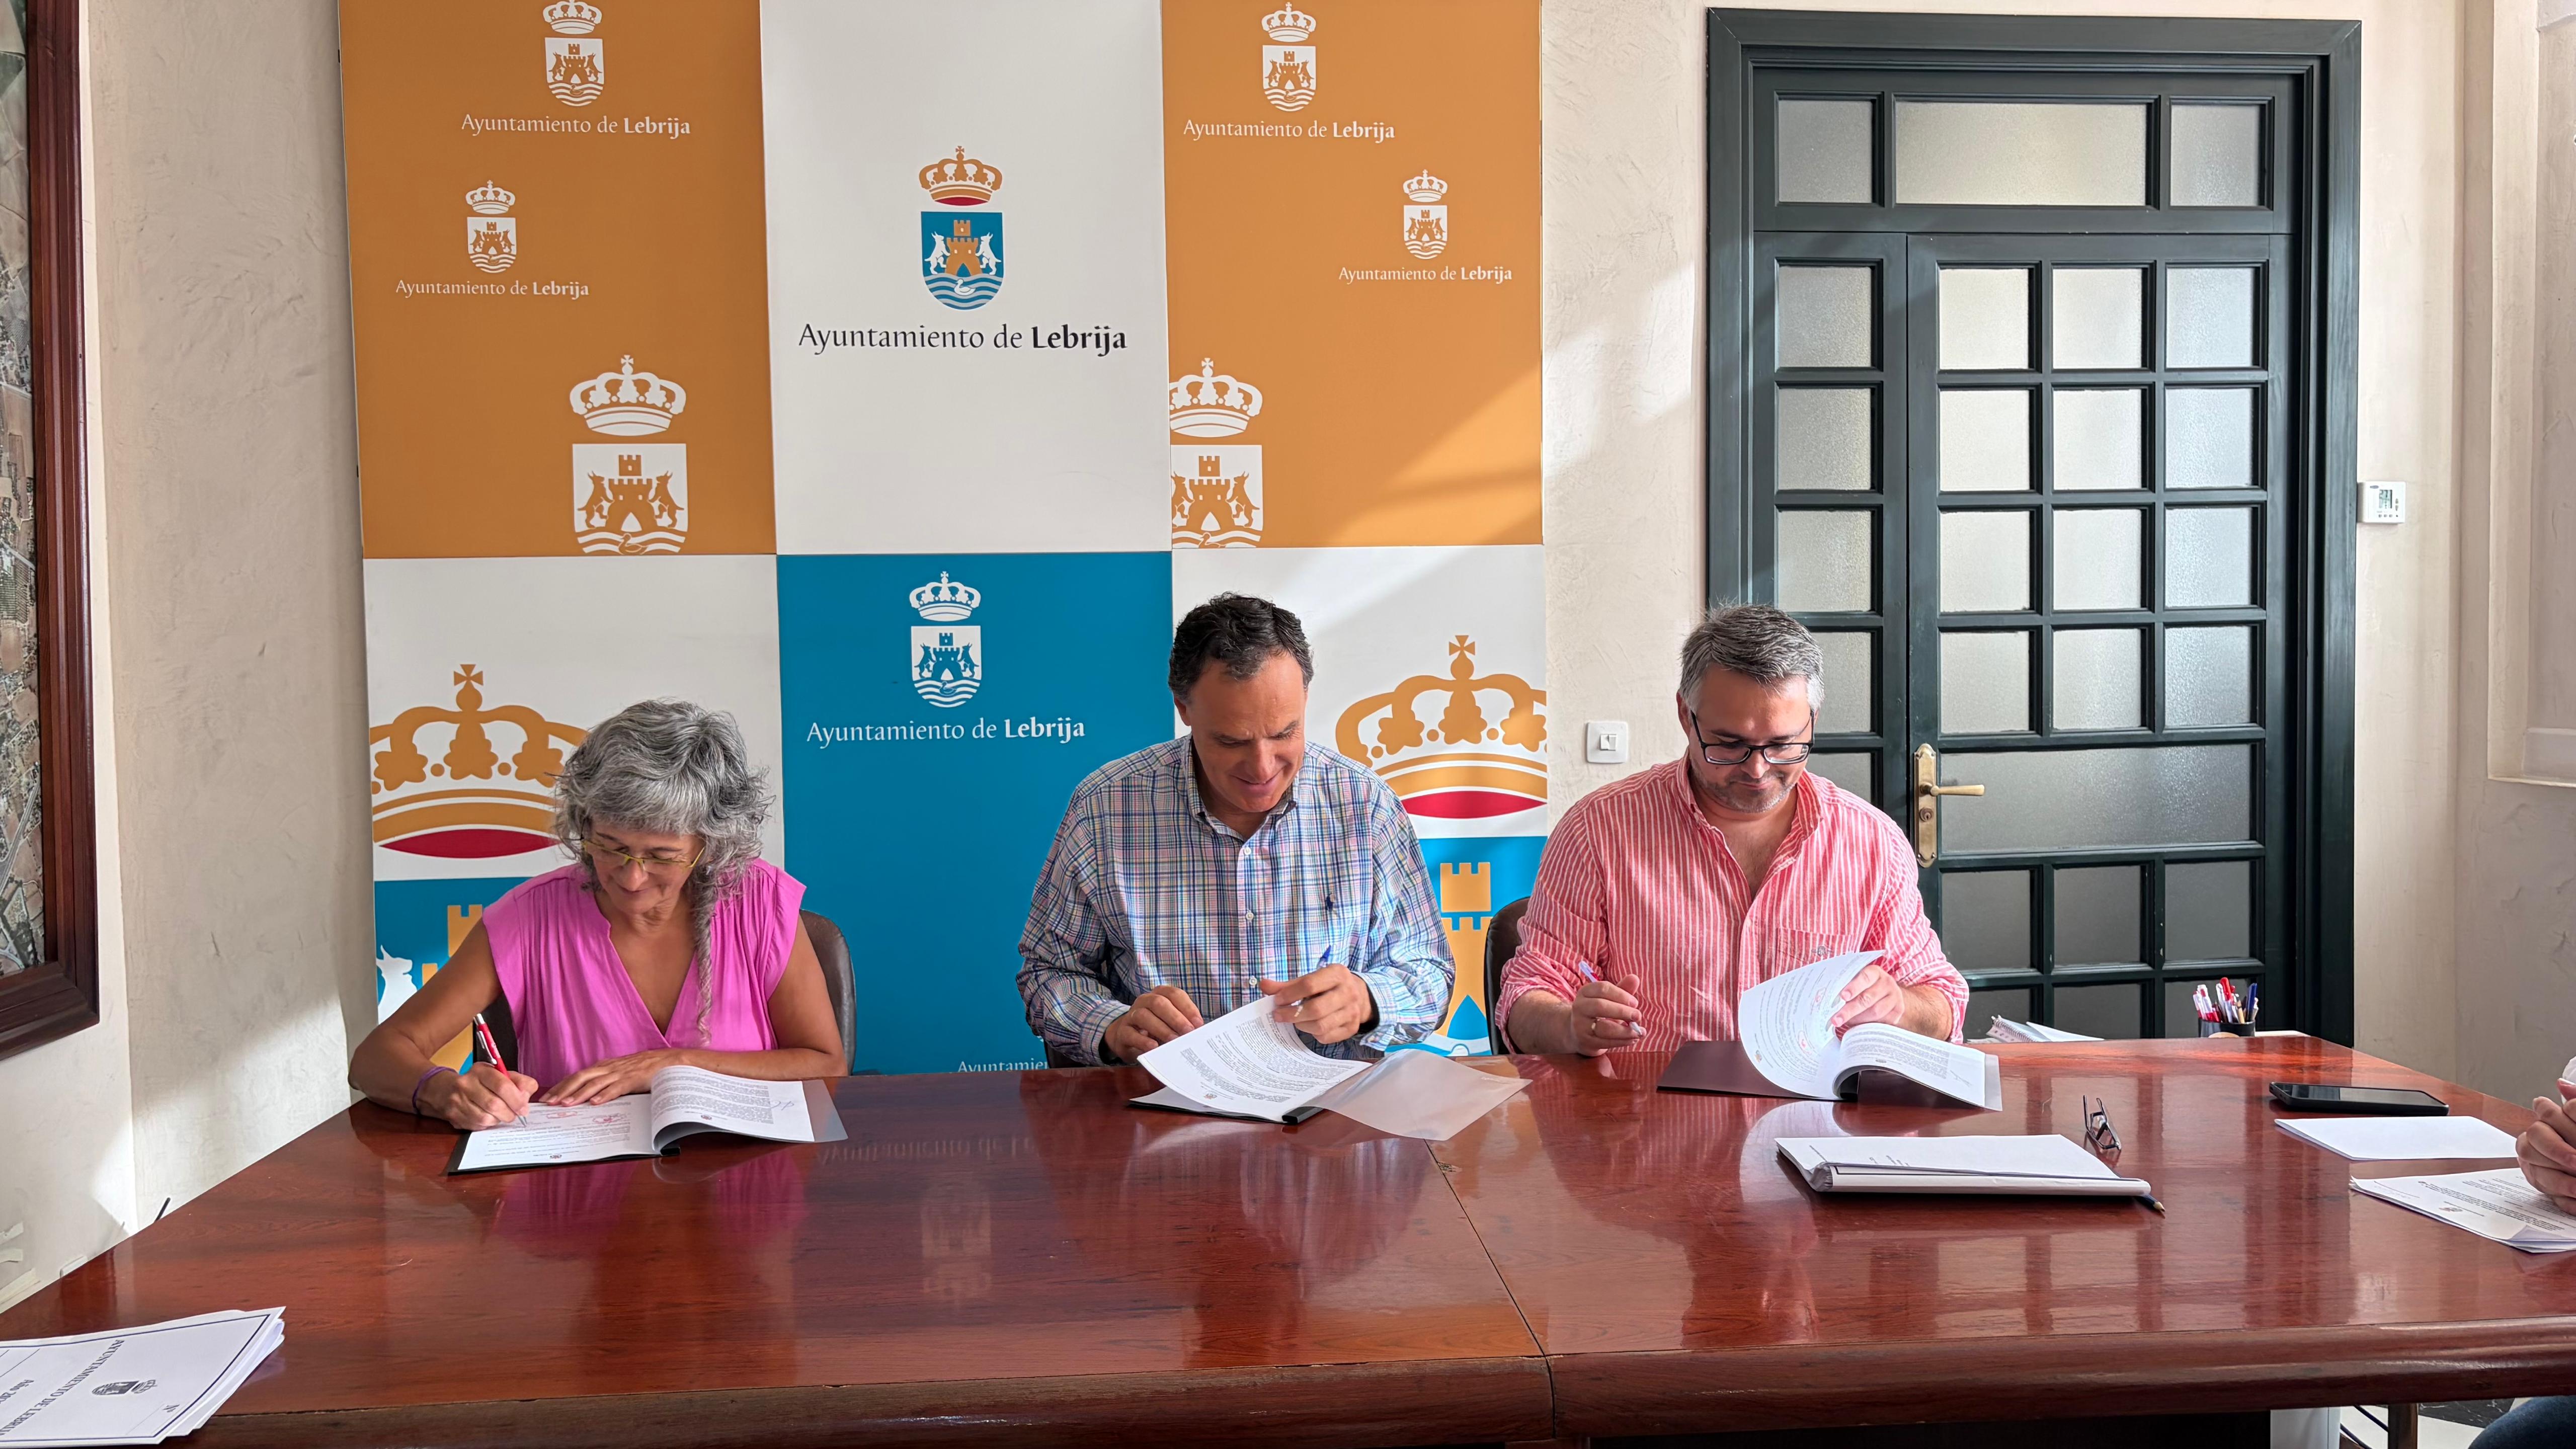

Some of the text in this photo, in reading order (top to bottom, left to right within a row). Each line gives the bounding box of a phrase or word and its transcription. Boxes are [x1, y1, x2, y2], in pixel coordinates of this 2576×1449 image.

[461, 114, 690, 139] Ayuntamiento de Lebrija
[1183, 119, 1395, 143] Ayuntamiento de Lebrija
[1339, 266, 1512, 285] Ayuntamiento de Lebrija
[396, 280, 589, 300] Ayuntamiento de Lebrija
[798, 323, 1128, 357] Ayuntamiento de Lebrija
[807, 716, 1085, 749] Ayuntamiento de Lebrija
[50, 1339, 125, 1397] AYUNTAMIENTO
[34, 1398, 56, 1408] DE
